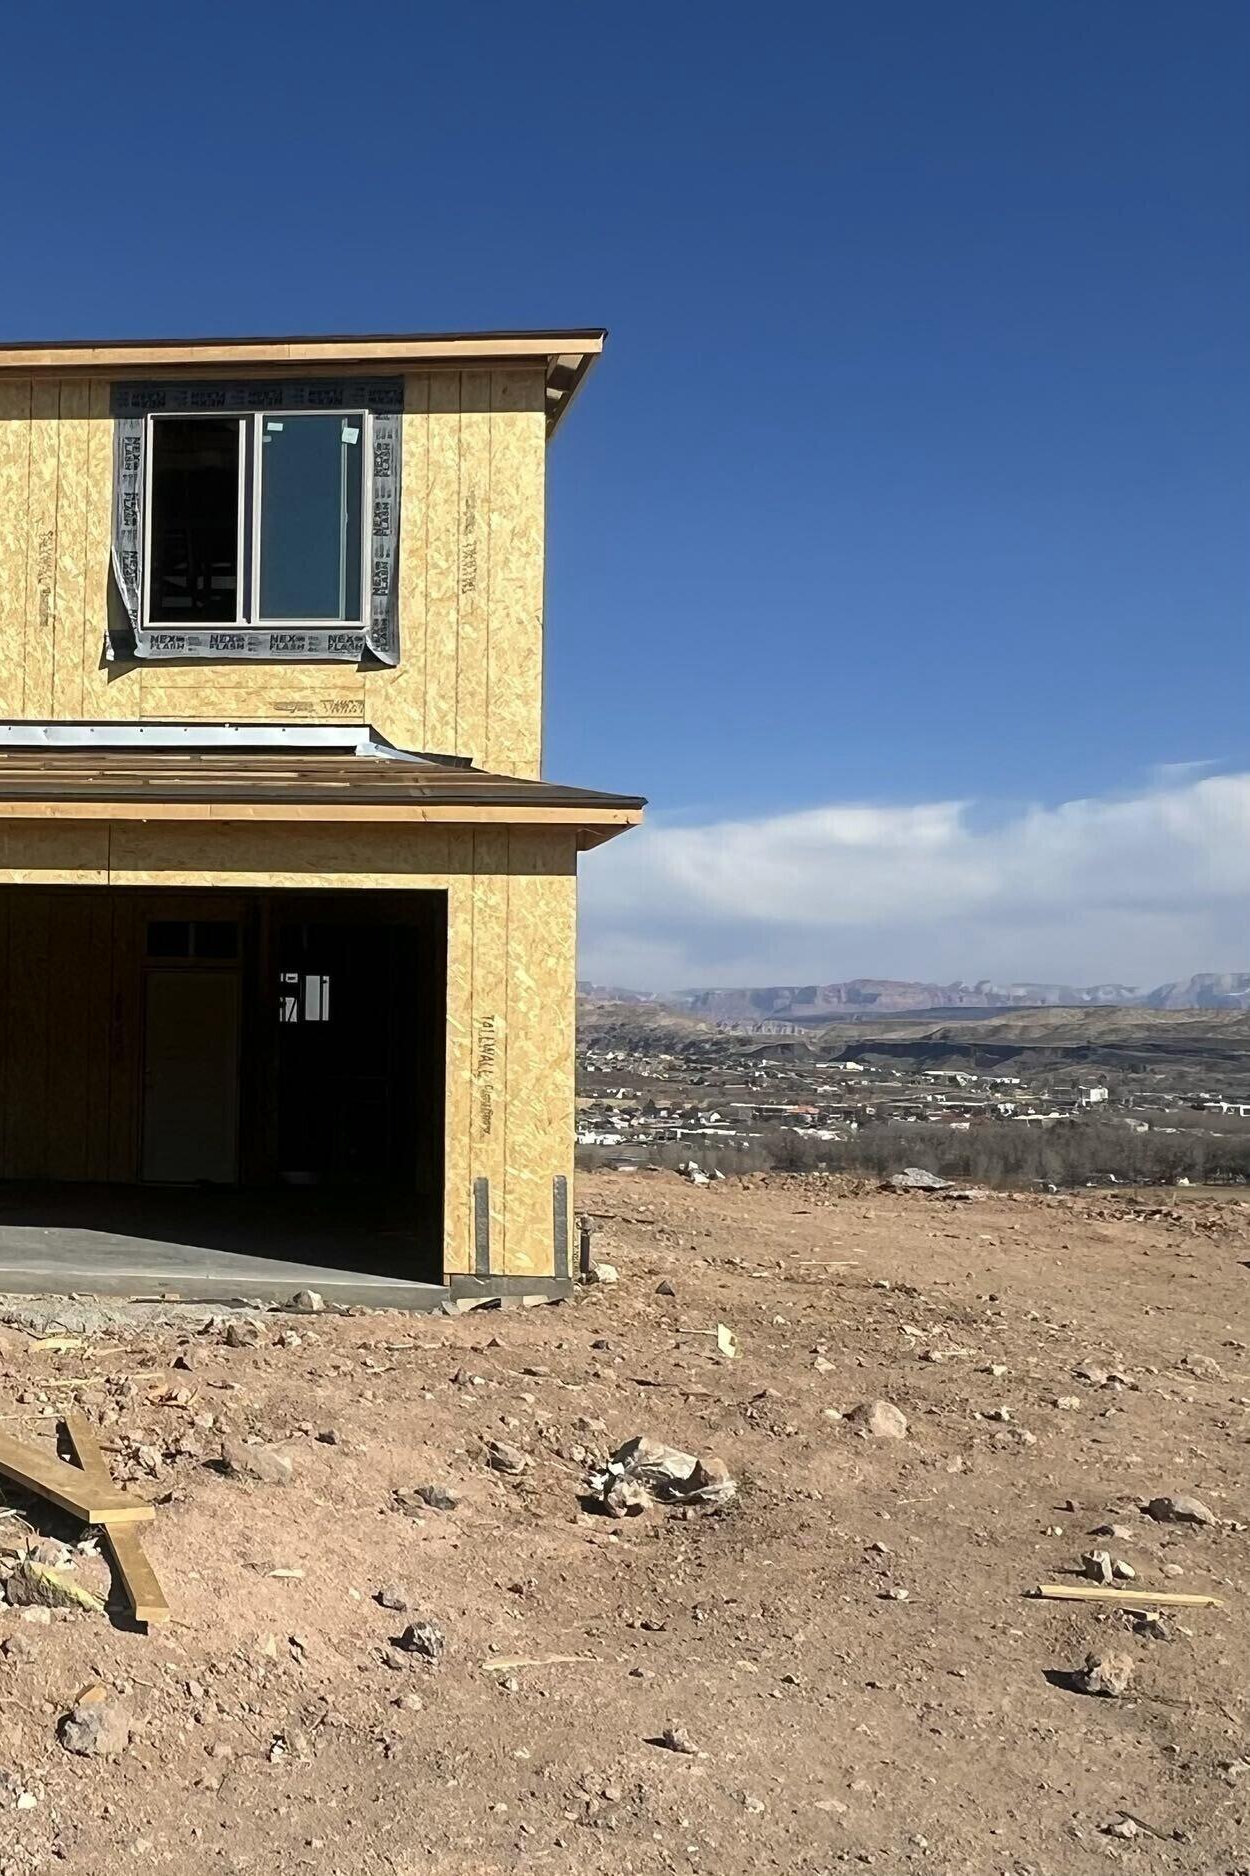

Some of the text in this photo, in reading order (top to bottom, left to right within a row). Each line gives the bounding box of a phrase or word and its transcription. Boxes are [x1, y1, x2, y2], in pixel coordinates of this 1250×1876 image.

[150, 635, 177, 643] NEX
[210, 635, 237, 643] NEX
[270, 634, 297, 643] NEX
[328, 635, 356, 643] NEX
[150, 642, 184, 650] FLASH
[210, 642, 244, 650] FLASH
[270, 642, 305, 650] FLASH
